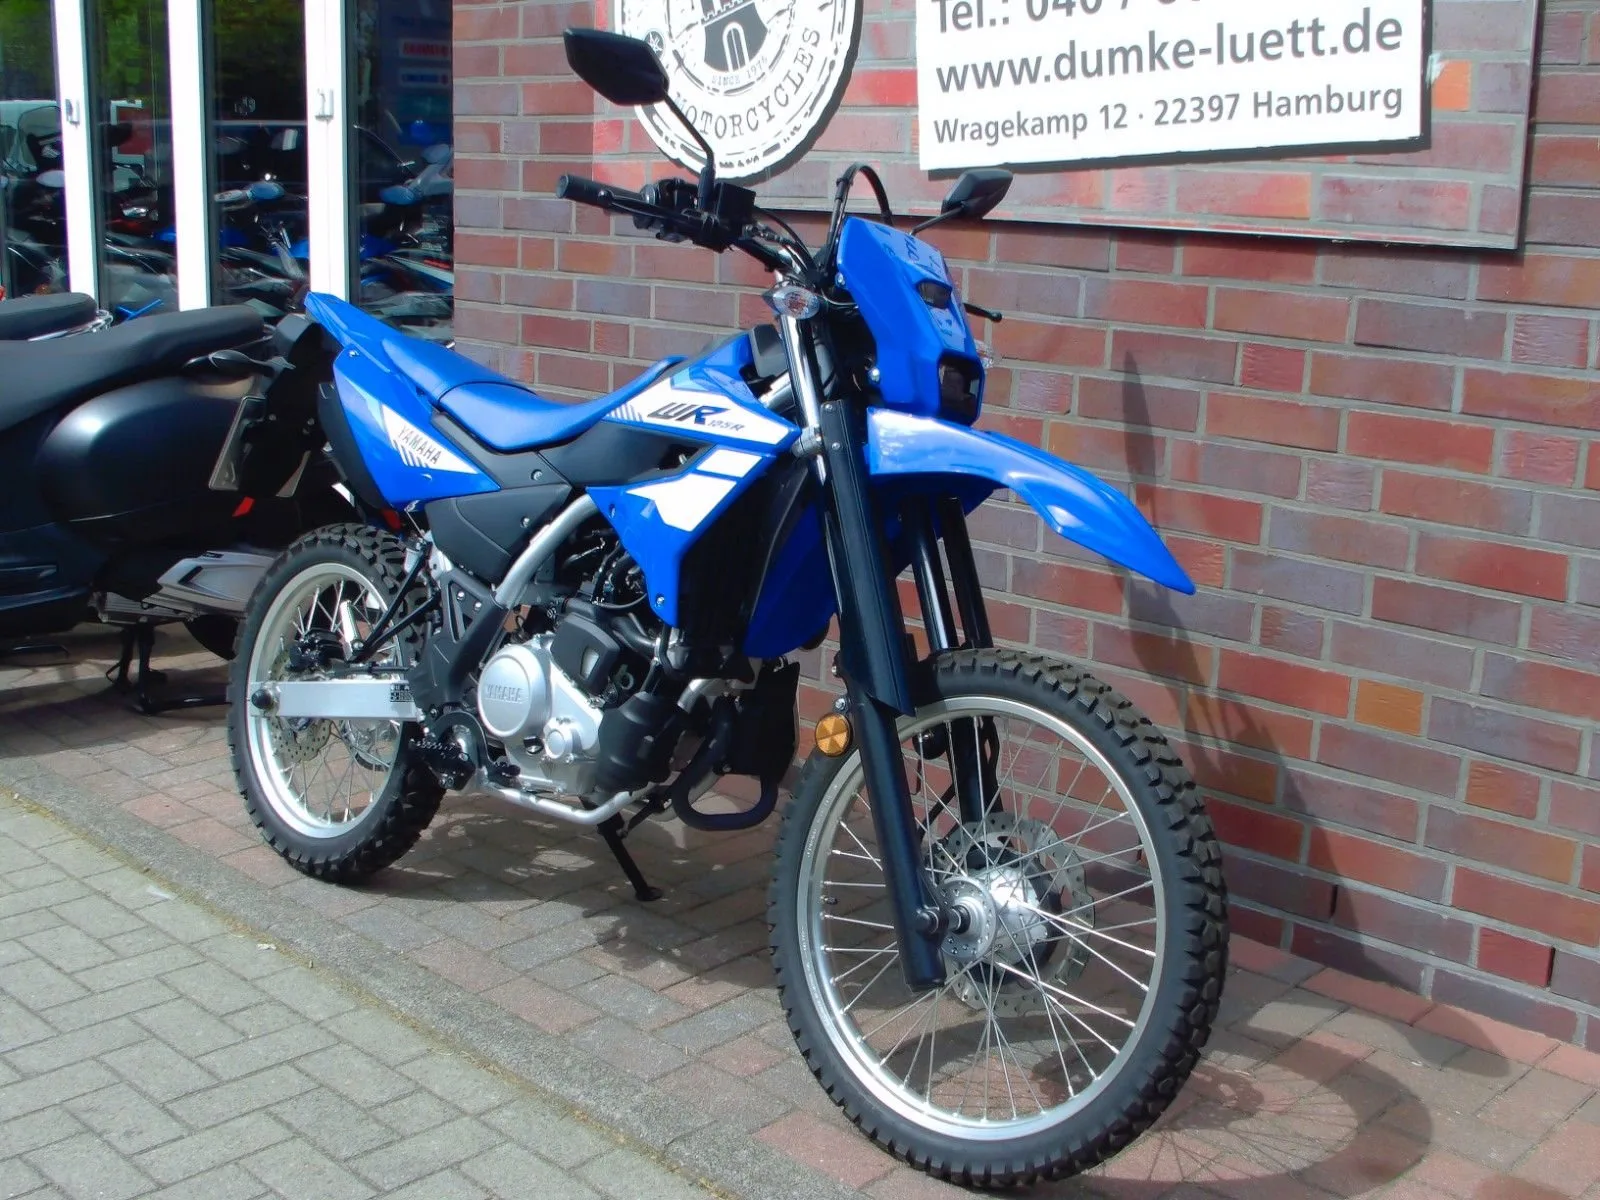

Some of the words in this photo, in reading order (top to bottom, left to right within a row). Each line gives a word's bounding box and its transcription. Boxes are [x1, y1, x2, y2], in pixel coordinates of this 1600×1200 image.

[936, 6, 1403, 93] www.dumke-luett.de
[933, 111, 1088, 147] Wragekamp
[1099, 103, 1128, 130] 12
[1154, 93, 1240, 126] 22397
[1253, 84, 1403, 119] Hamburg
[647, 402, 731, 425] WR
[397, 424, 442, 465] YAMAHA
